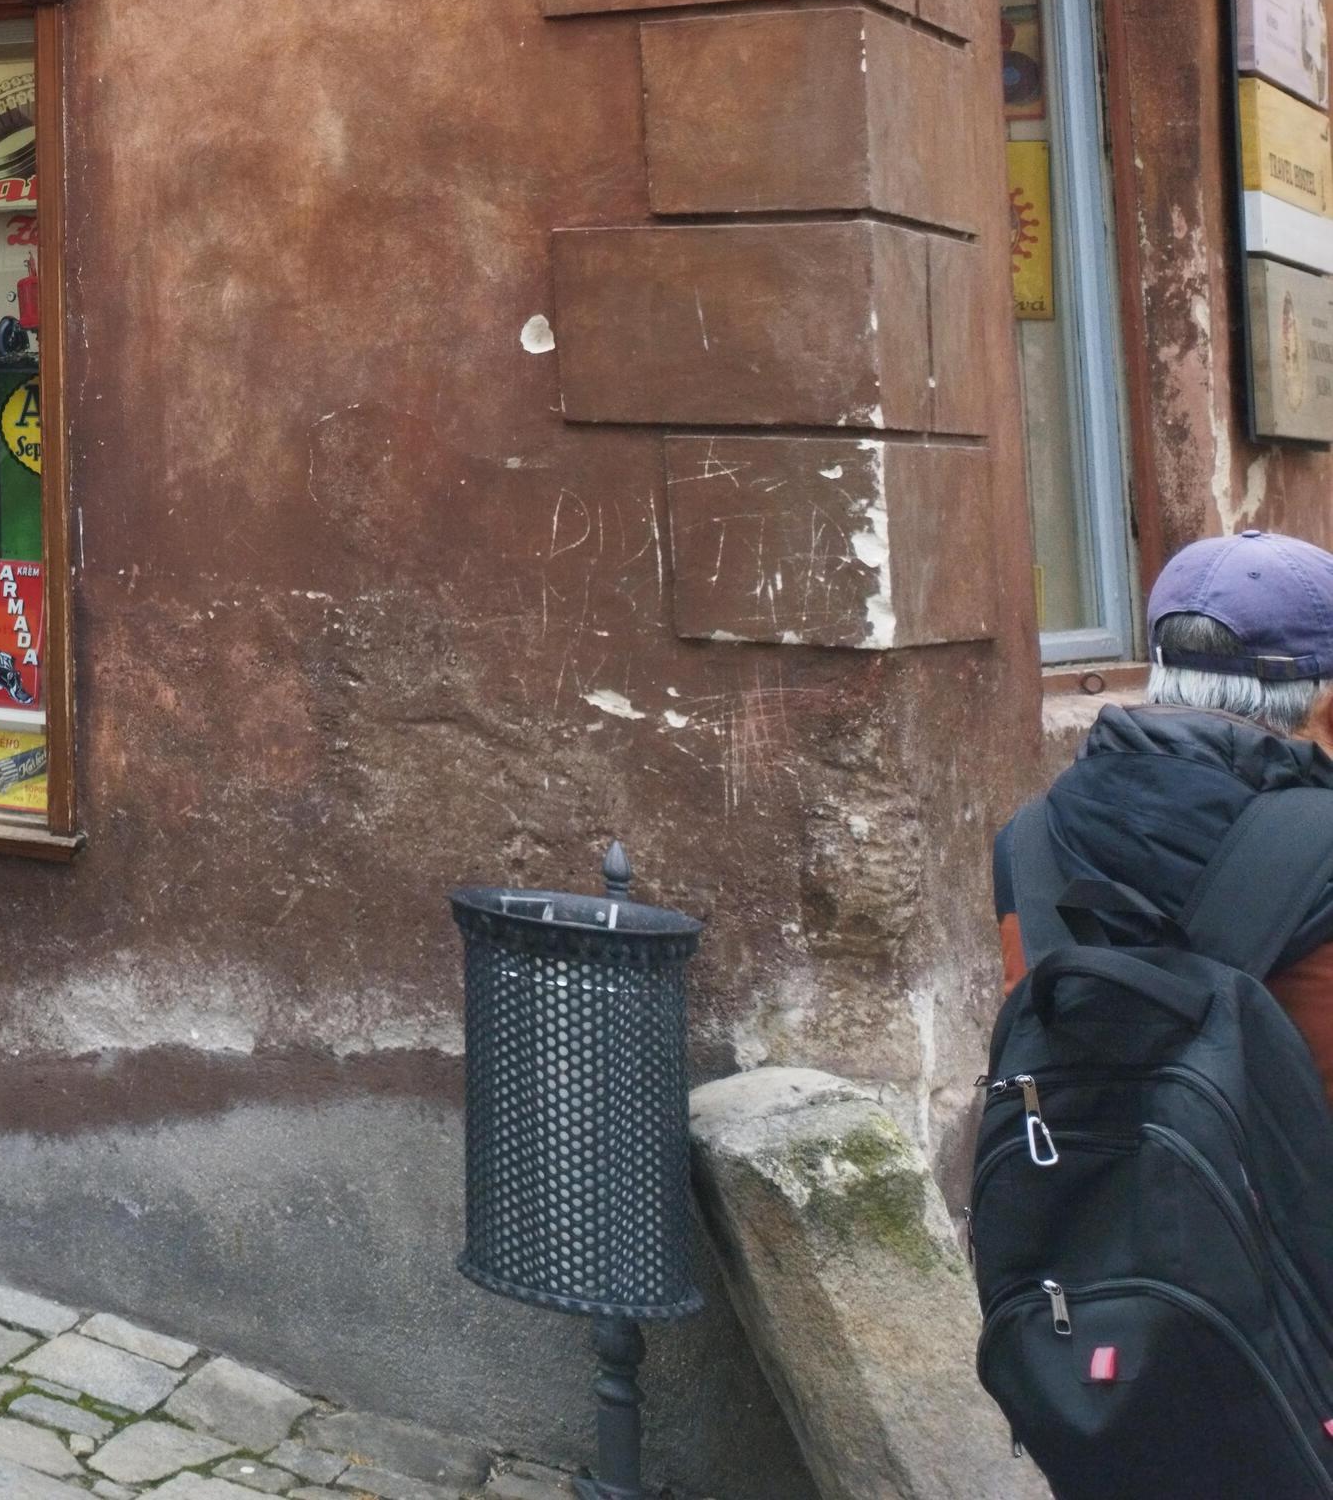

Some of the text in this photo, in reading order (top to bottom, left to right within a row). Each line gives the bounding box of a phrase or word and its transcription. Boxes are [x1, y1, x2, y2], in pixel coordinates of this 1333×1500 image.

[1269, 152, 1318, 197] TRAVEL HOSTEL
[0, 564, 39, 666] ARMADA
